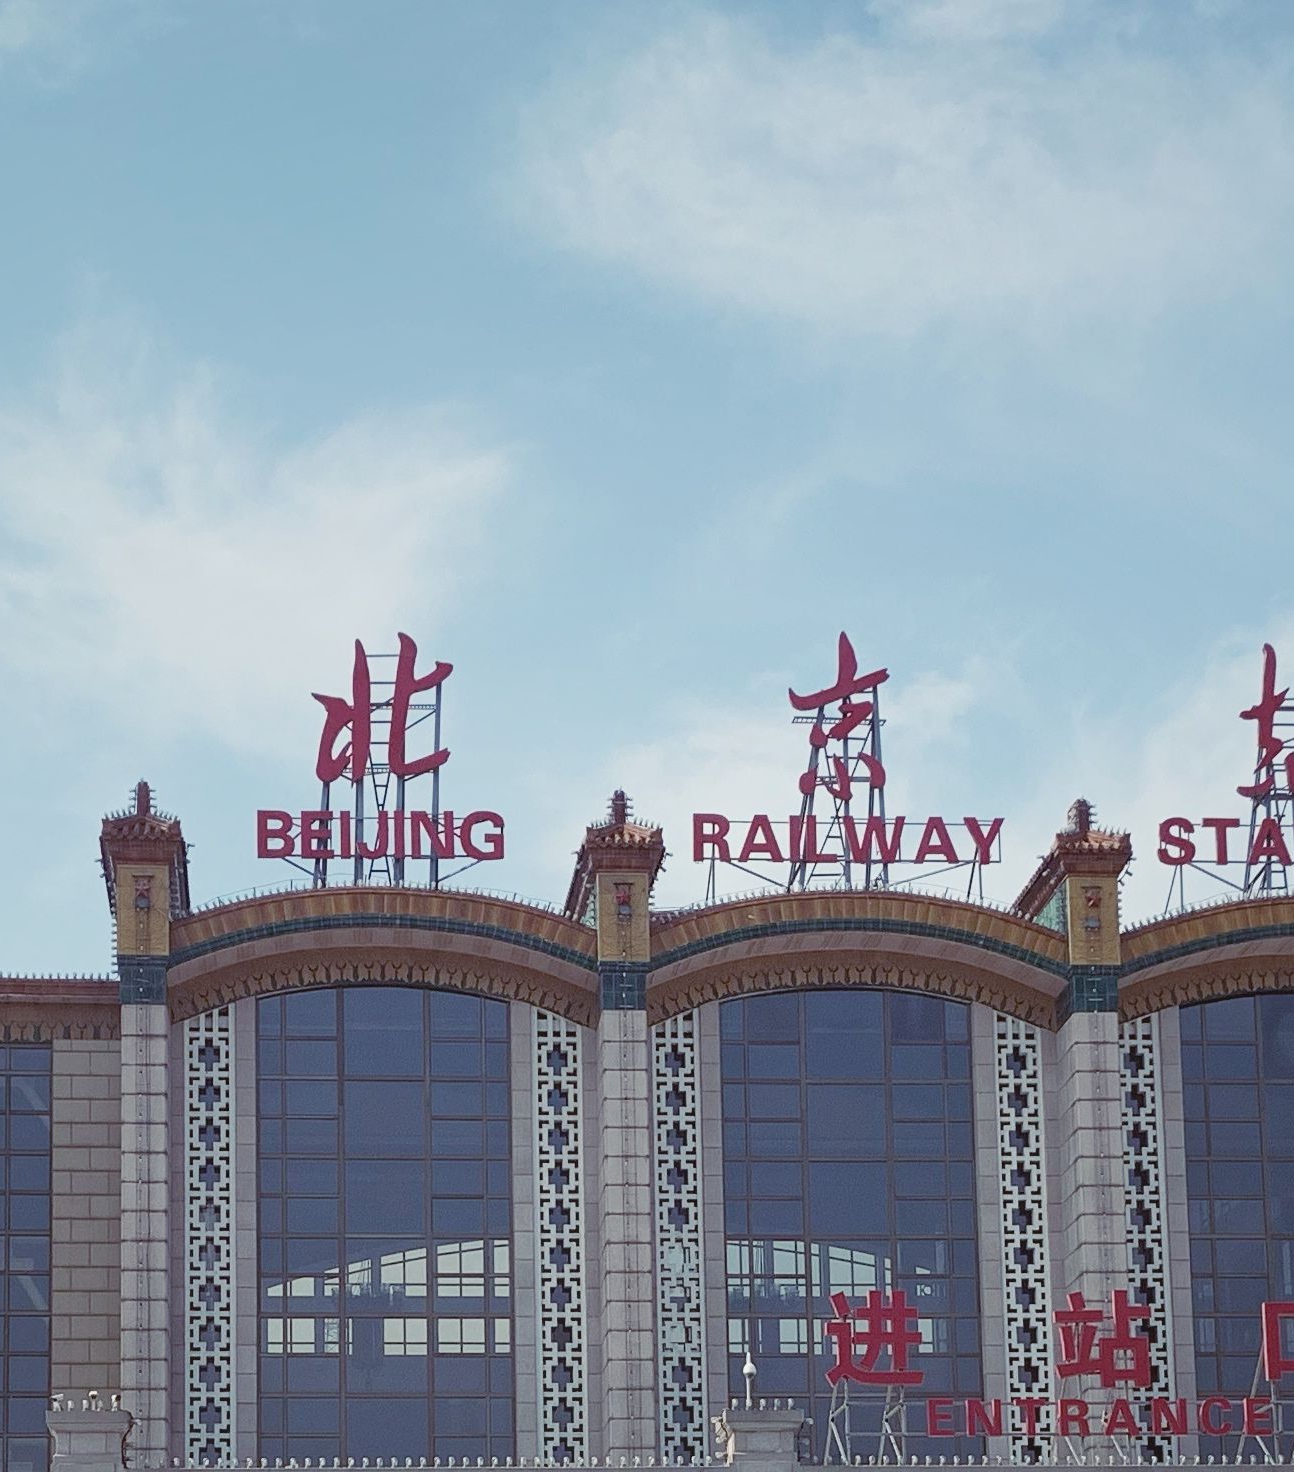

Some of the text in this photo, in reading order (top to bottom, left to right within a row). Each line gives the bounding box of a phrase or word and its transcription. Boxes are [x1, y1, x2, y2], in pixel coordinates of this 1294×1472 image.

[256, 810, 505, 860] BEIJING
[692, 813, 1004, 865] RAILWAY
[926, 1397, 1274, 1438] ENTRANCE
